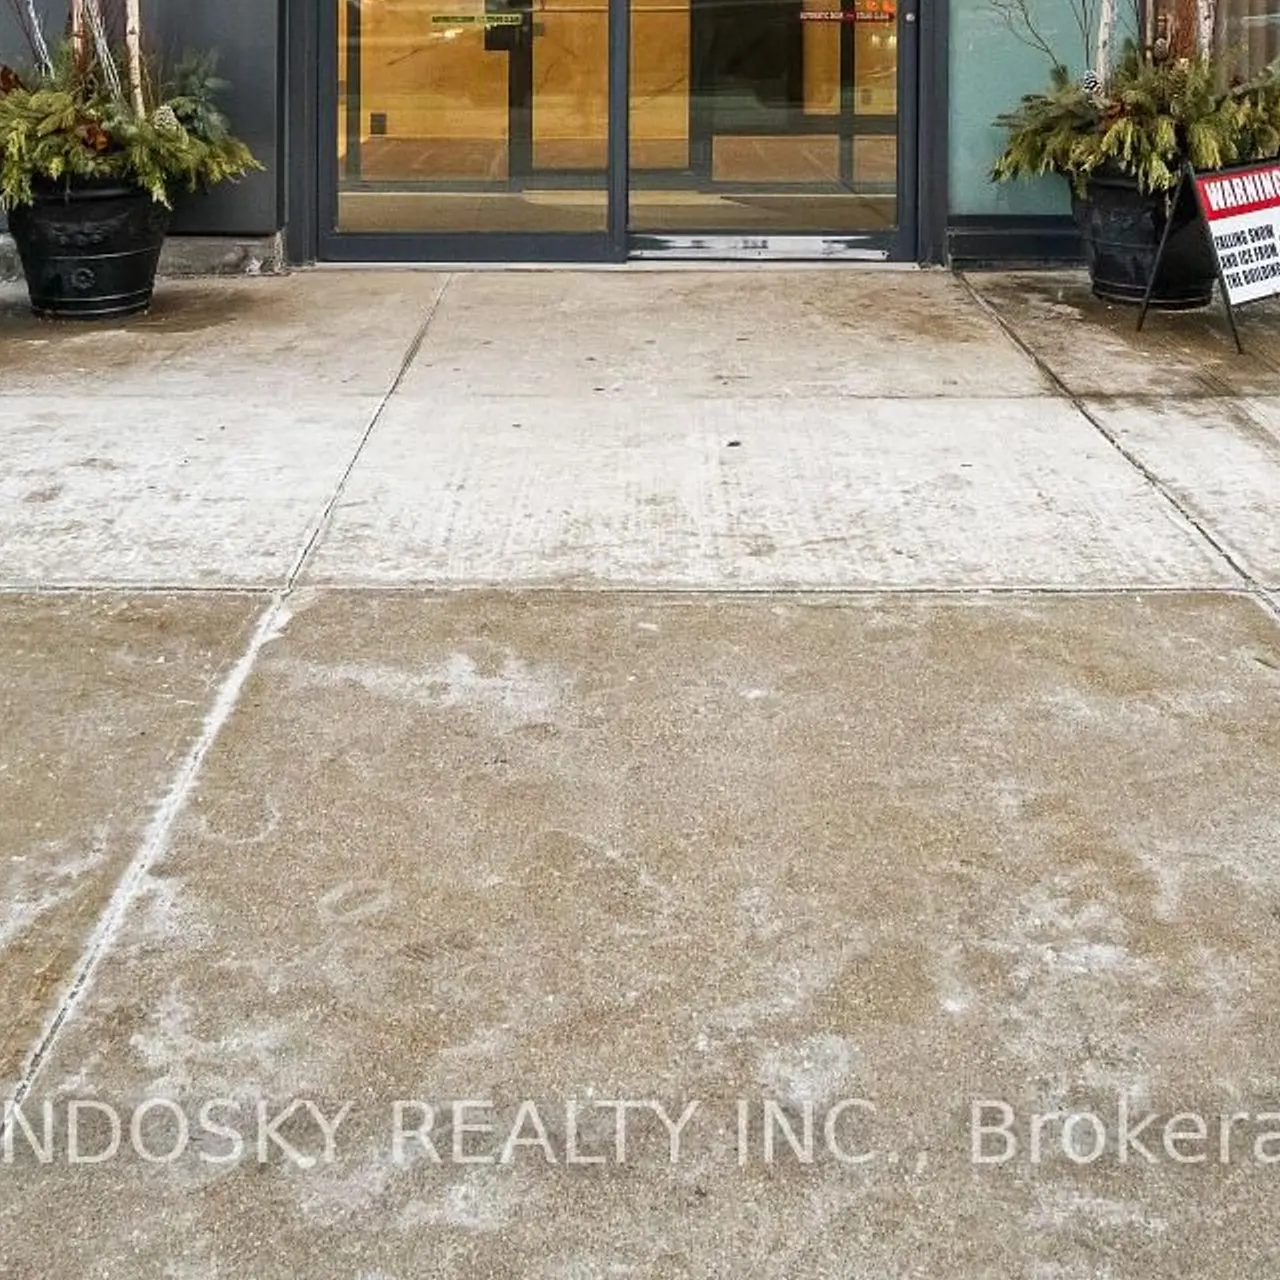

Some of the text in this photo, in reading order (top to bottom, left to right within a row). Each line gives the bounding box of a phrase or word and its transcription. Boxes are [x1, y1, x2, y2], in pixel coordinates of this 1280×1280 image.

[1214, 224, 1274, 250] FALLING SNOW
[1220, 242, 1279, 270] AND ICE FROM
[1226, 272, 1243, 289] THE
